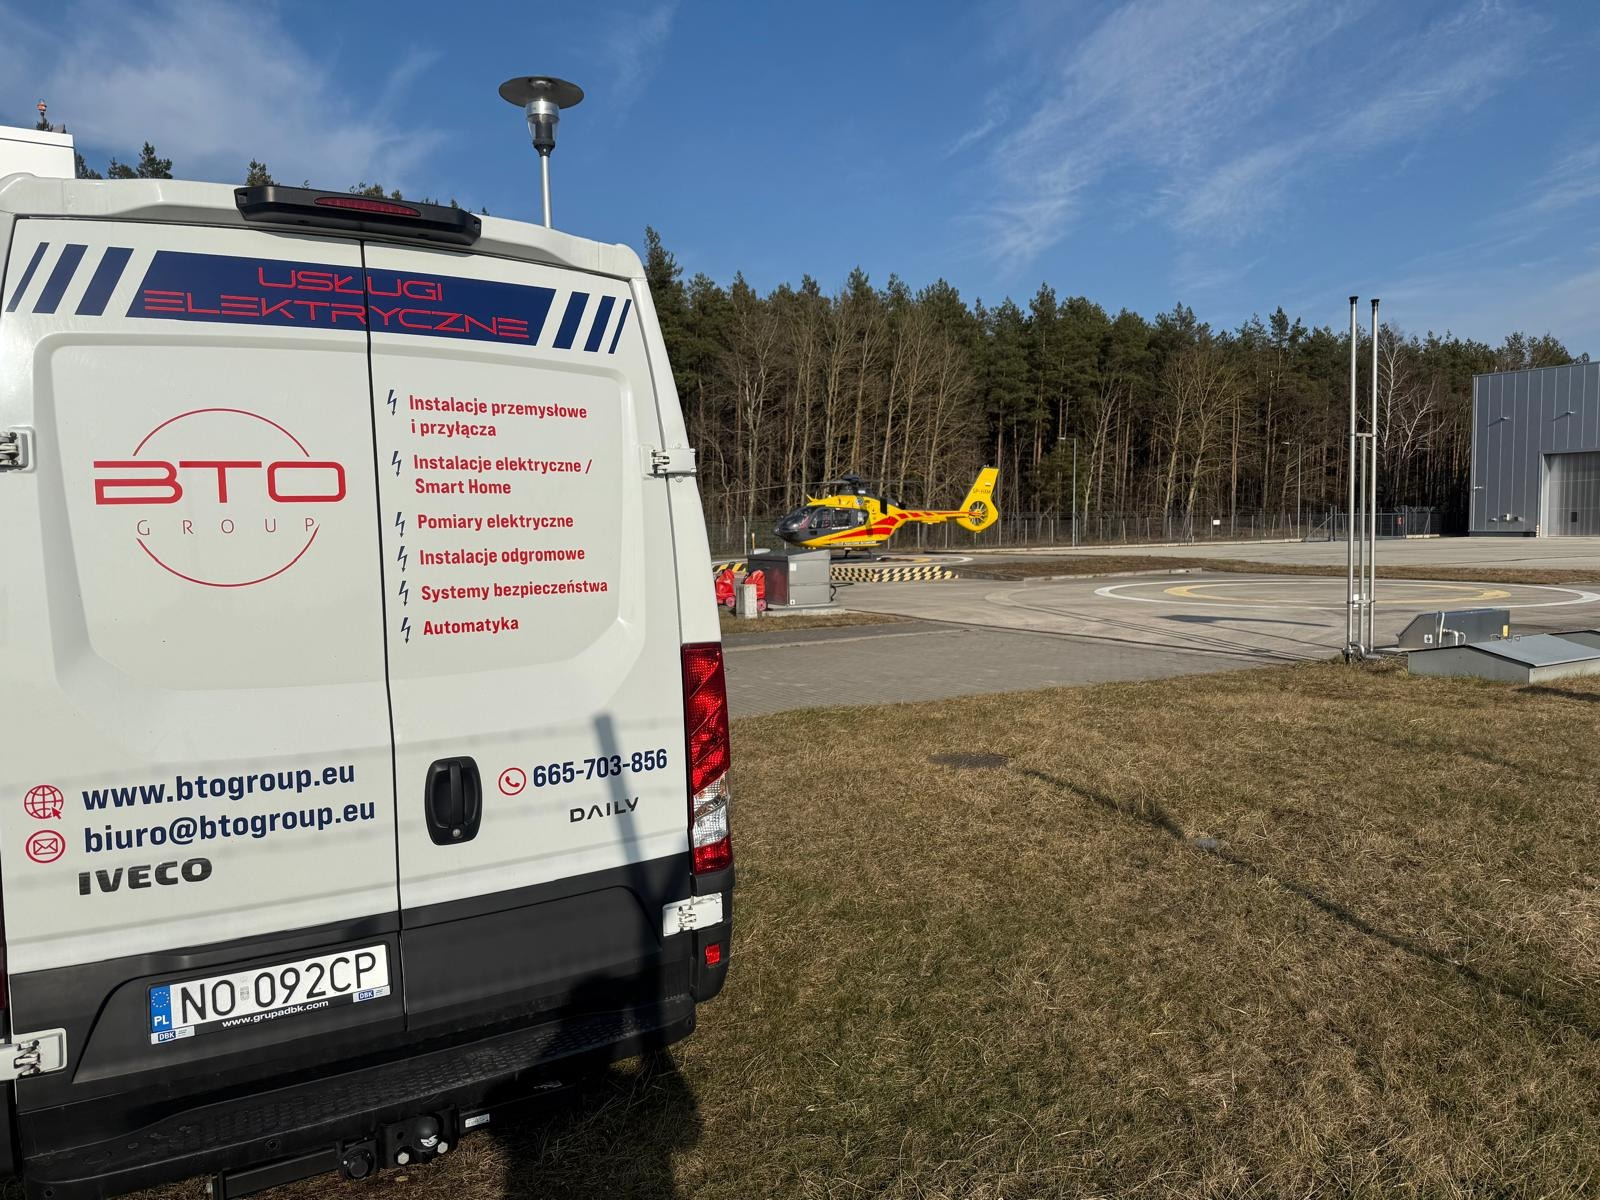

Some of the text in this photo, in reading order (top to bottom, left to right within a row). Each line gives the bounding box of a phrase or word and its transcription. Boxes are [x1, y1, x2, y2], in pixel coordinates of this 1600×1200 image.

[258, 266, 444, 300] USŁUGI
[144, 290, 530, 339] ELEKTRYCZNE
[409, 395, 588, 419] Instalacje przemysłowe
[411, 419, 497, 438] i przyłącza
[413, 455, 593, 474] Instalacje elektryczne /
[94, 461, 346, 505] BTO
[415, 478, 512, 494] Smart Home
[136, 517, 315, 536] GROUP
[417, 514, 574, 531] Pomiary elektryczne
[419, 548, 585, 566] Instalacje odgromowe
[421, 579, 608, 603] Systemy bezpieczeństwa
[423, 616, 519, 636] Automatyka
[533, 749, 667, 787] 665-703-856
[82, 765, 356, 810] www.btogroup.eu
[570, 797, 639, 823] DAILY
[84, 801, 376, 853] biuro@btogroup.eu
[78, 857, 213, 895] IVECO
[180, 951, 377, 1024] NO 092CP
[154, 1015, 170, 1027] PL
[222, 1000, 329, 1028] www.grupadbk.com
[159, 1031, 175, 1041] DBK
